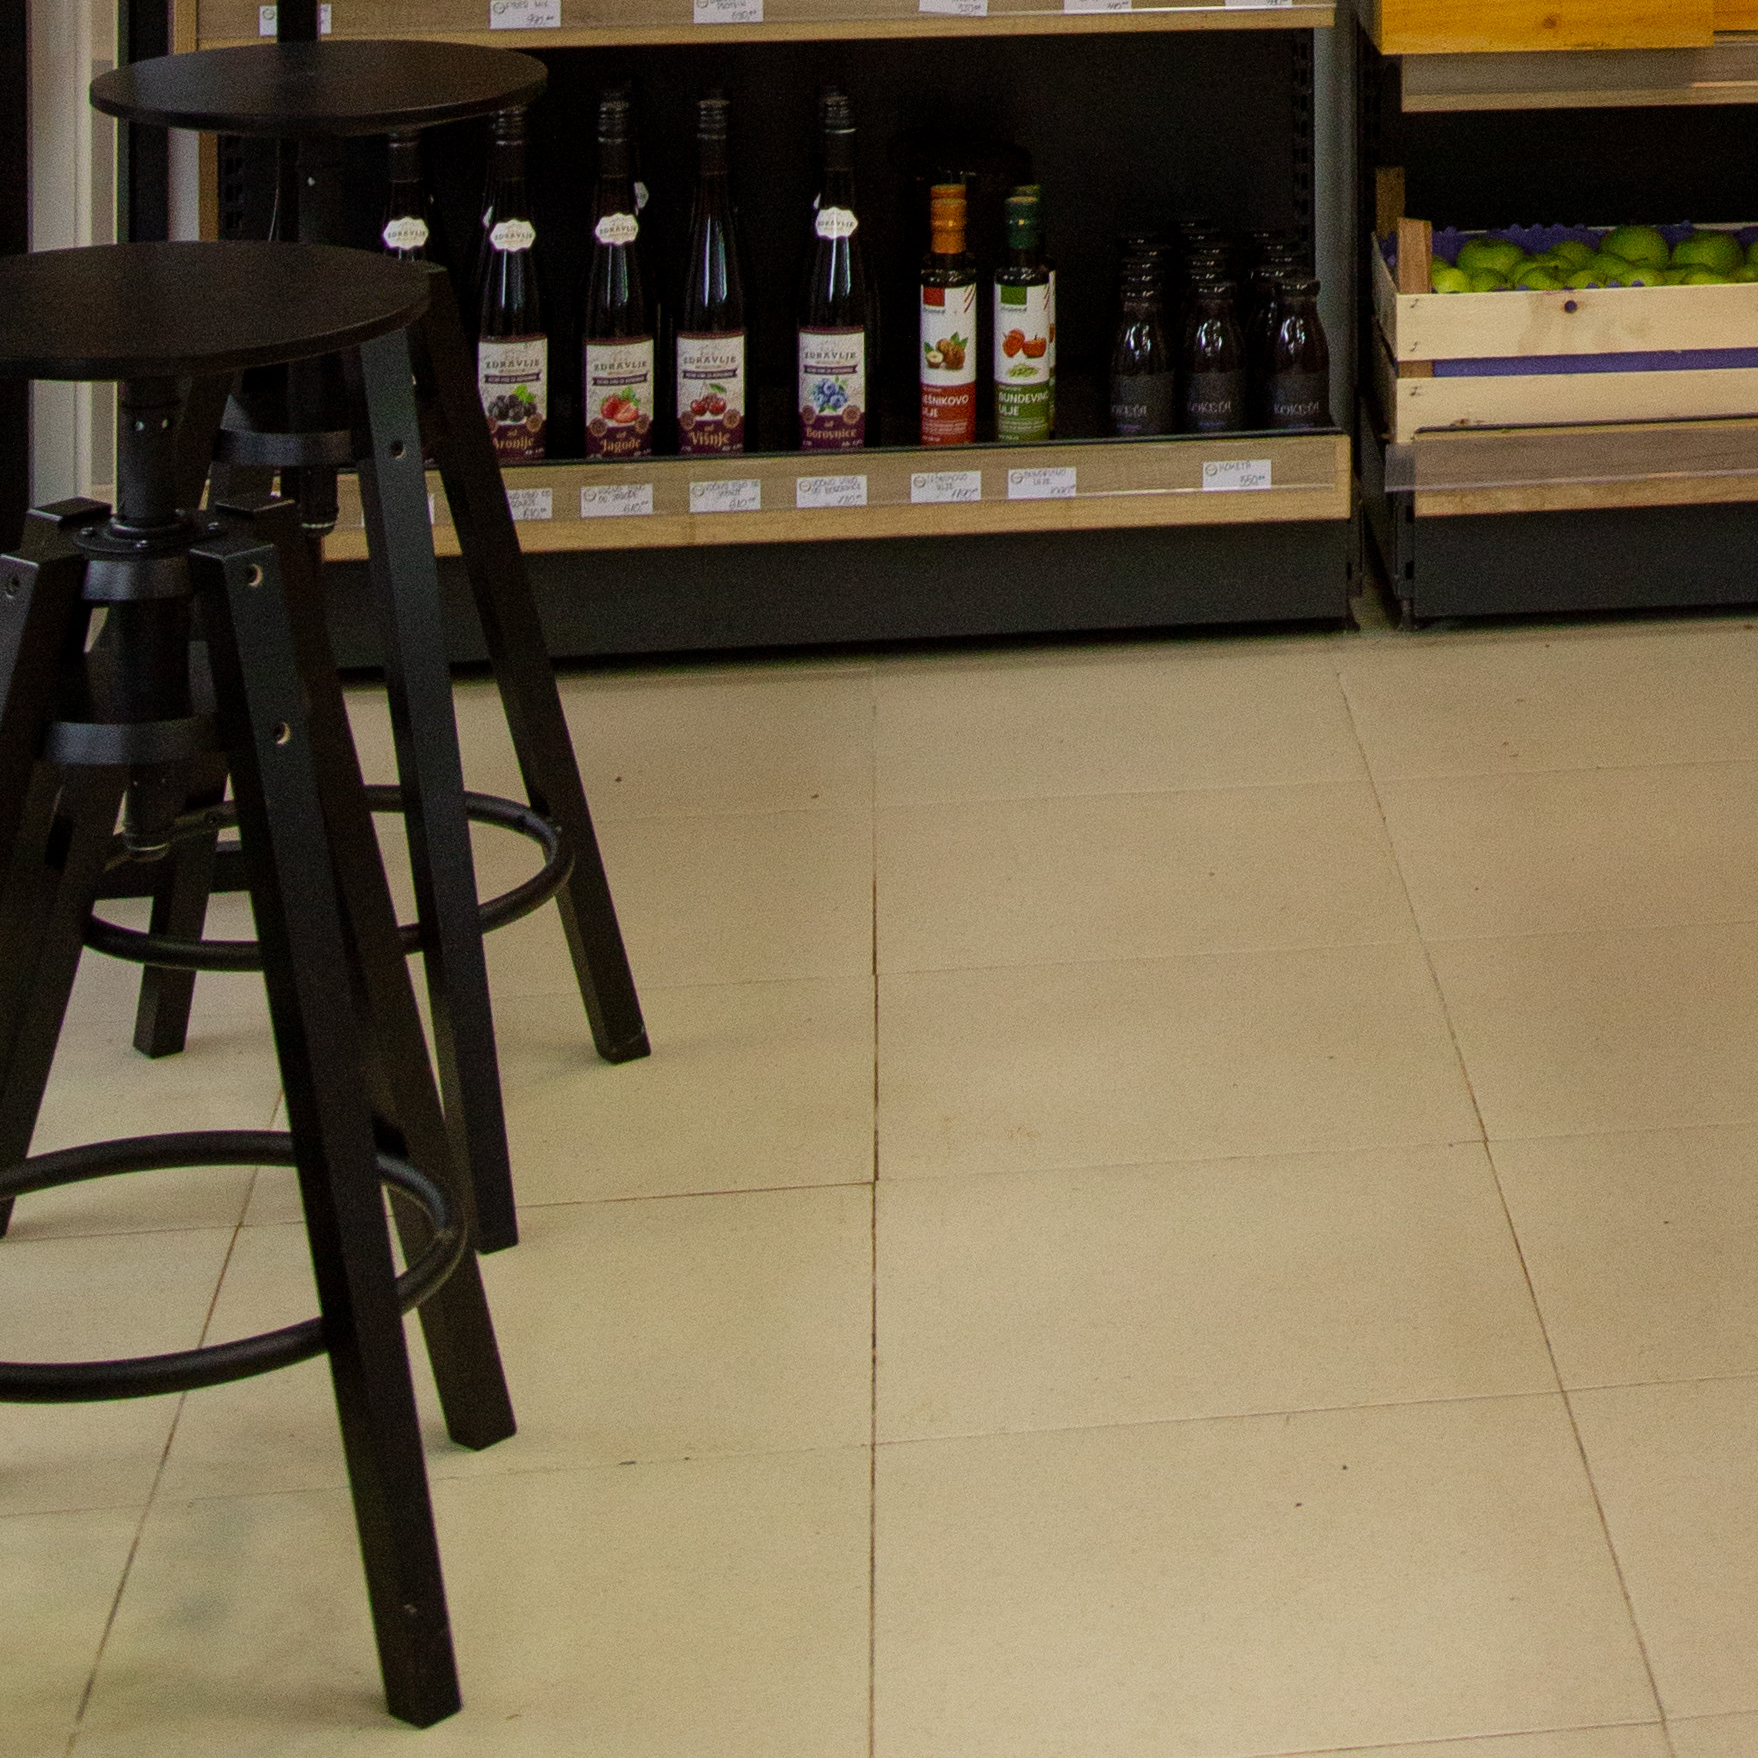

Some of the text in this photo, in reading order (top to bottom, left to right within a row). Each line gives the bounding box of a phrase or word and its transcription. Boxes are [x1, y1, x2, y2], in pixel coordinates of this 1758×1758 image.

[683, 355, 737, 365] ZDRAVLJE
[804, 351, 857, 360] ZDRAVLJE
[486, 359, 540, 369] ZDRAVLJE
[594, 361, 647, 371] ZDRAVLJE
[690, 431, 730, 447] Višnje
